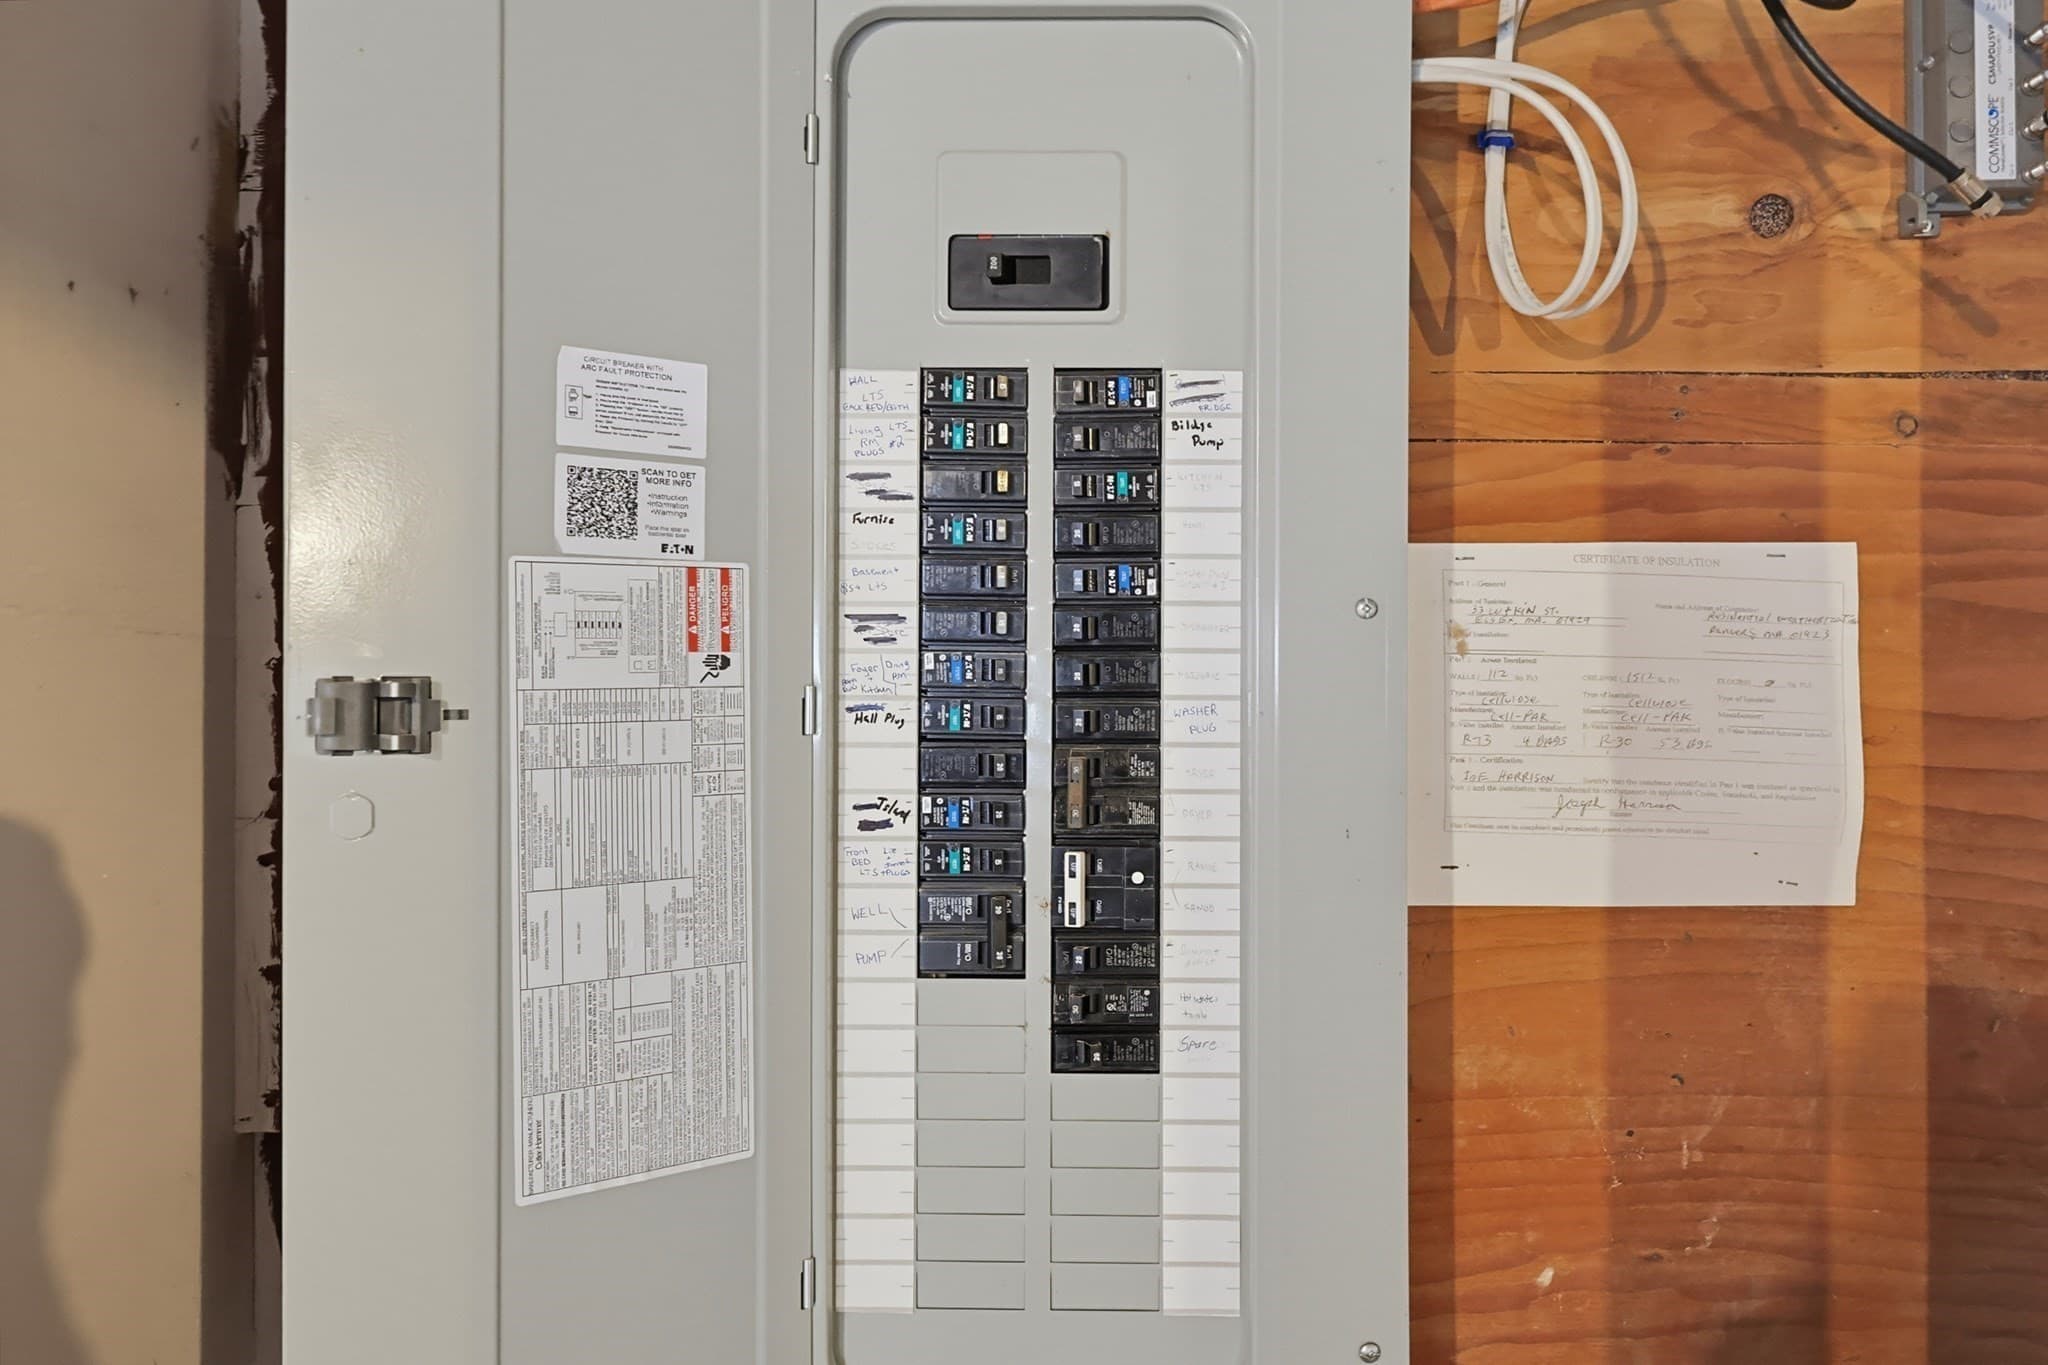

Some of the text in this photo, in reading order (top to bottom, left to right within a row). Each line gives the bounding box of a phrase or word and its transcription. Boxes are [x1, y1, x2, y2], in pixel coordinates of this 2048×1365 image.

[1988, 99, 1999, 174] COMMSCOPE
[583, 356, 664, 372] CIRCUIT BREAKER WITH
[581, 364, 673, 381] ARC FAULT PROTECTION
[1191, 434, 1225, 450] Pump
[641, 468, 696, 480] SCAN TO GET
[645, 477, 692, 488] MORE INFO
[1573, 554, 1721, 568] CERTIFICATE OF INSULATION
[852, 566, 899, 577] Basement
[688, 585, 697, 623] DANGER
[721, 584, 729, 623] PELIGRO
[1174, 703, 1218, 717] WASHER
[854, 711, 905, 729] Hall Plug
[1189, 723, 1217, 735] PLUG
[851, 857, 872, 866] BED
[851, 904, 888, 920] WELL
[856, 950, 887, 965] PUMP
[1177, 1035, 1217, 1053] Spare
